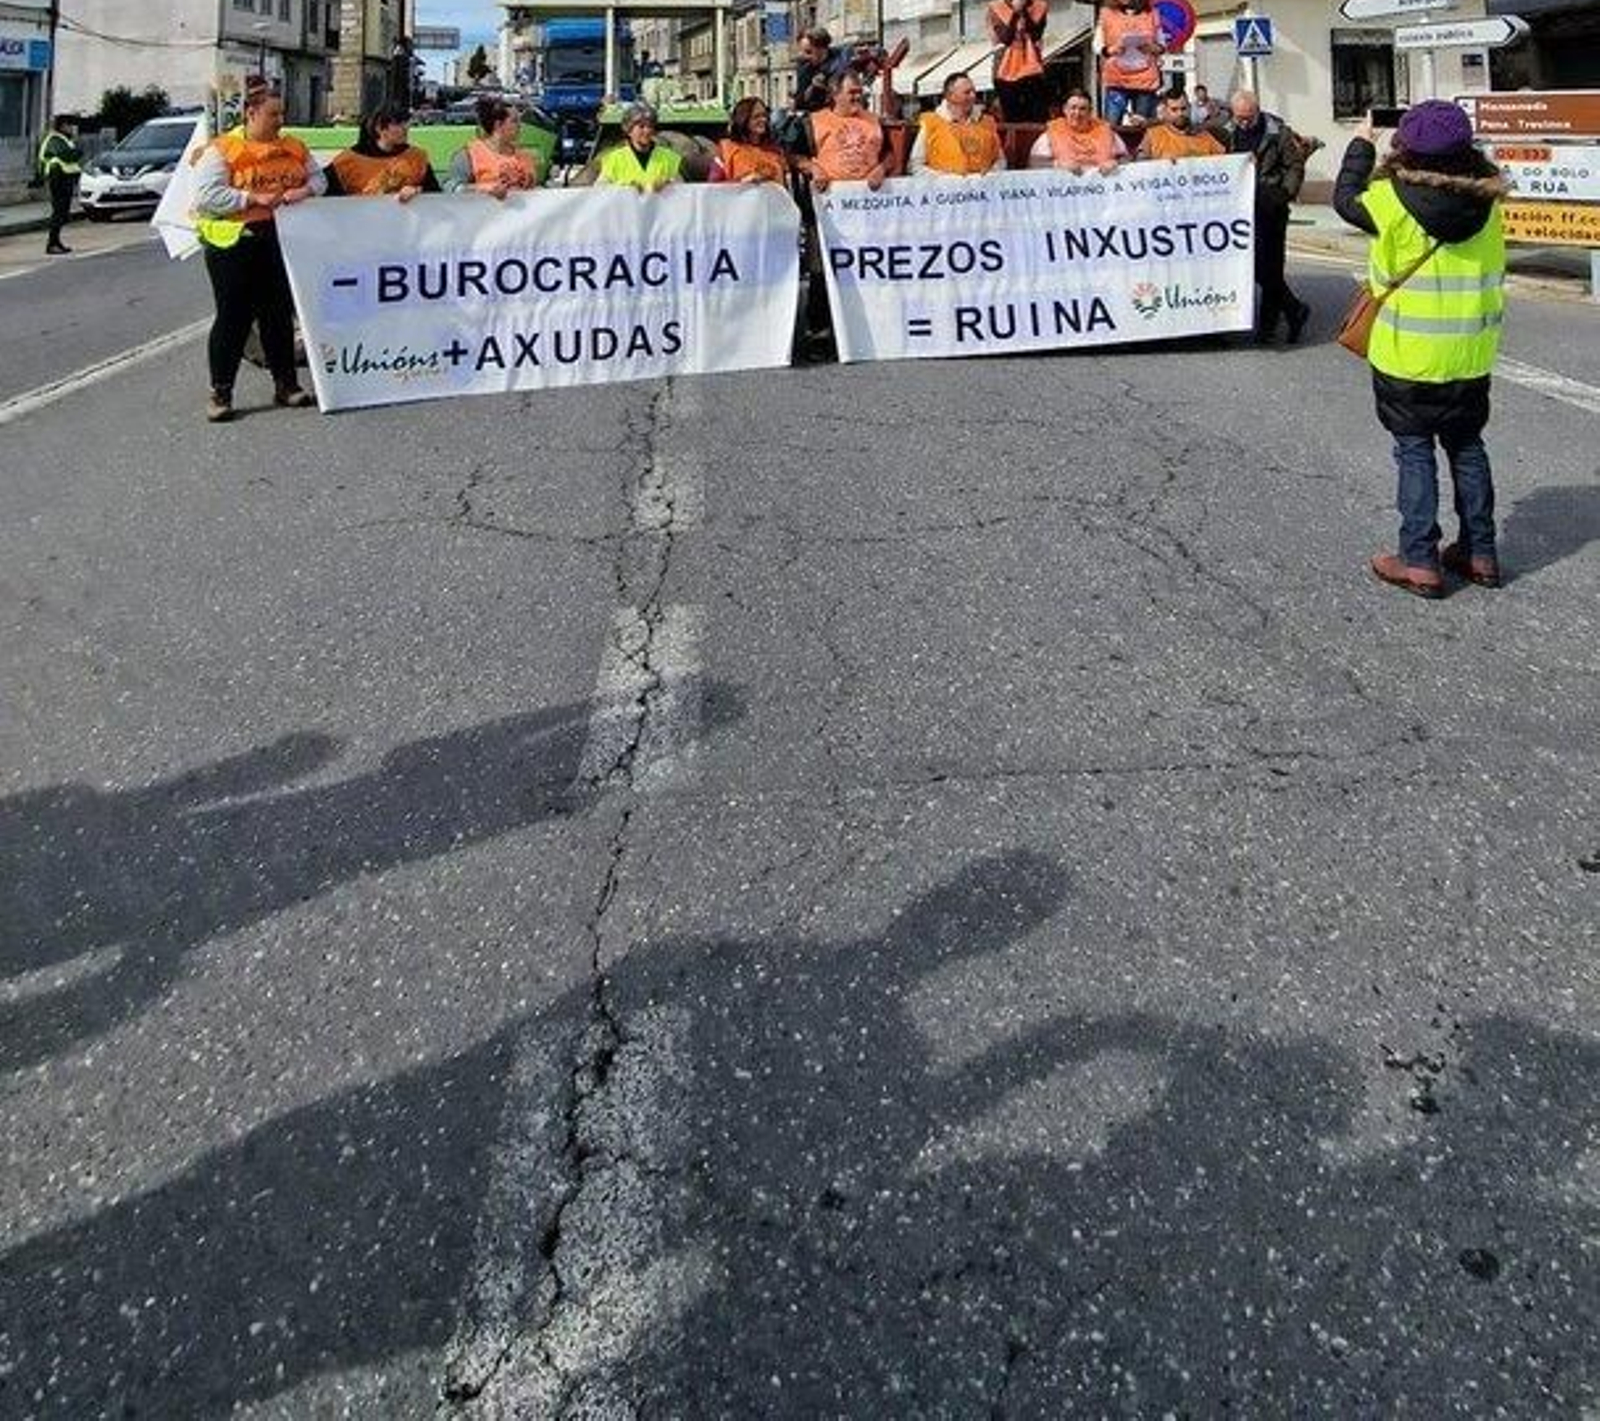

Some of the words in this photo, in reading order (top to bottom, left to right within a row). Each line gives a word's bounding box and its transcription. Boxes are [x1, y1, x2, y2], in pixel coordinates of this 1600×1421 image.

[1503, 211, 1553, 223] tación
[829, 240, 1004, 280] PREZOS
[1045, 219, 1251, 263] INXUSTOS
[376, 248, 740, 303] BUROCRACIA
[1164, 283, 1238, 310] Unións
[955, 296, 1117, 342] RUINA
[341, 341, 440, 374] Unións
